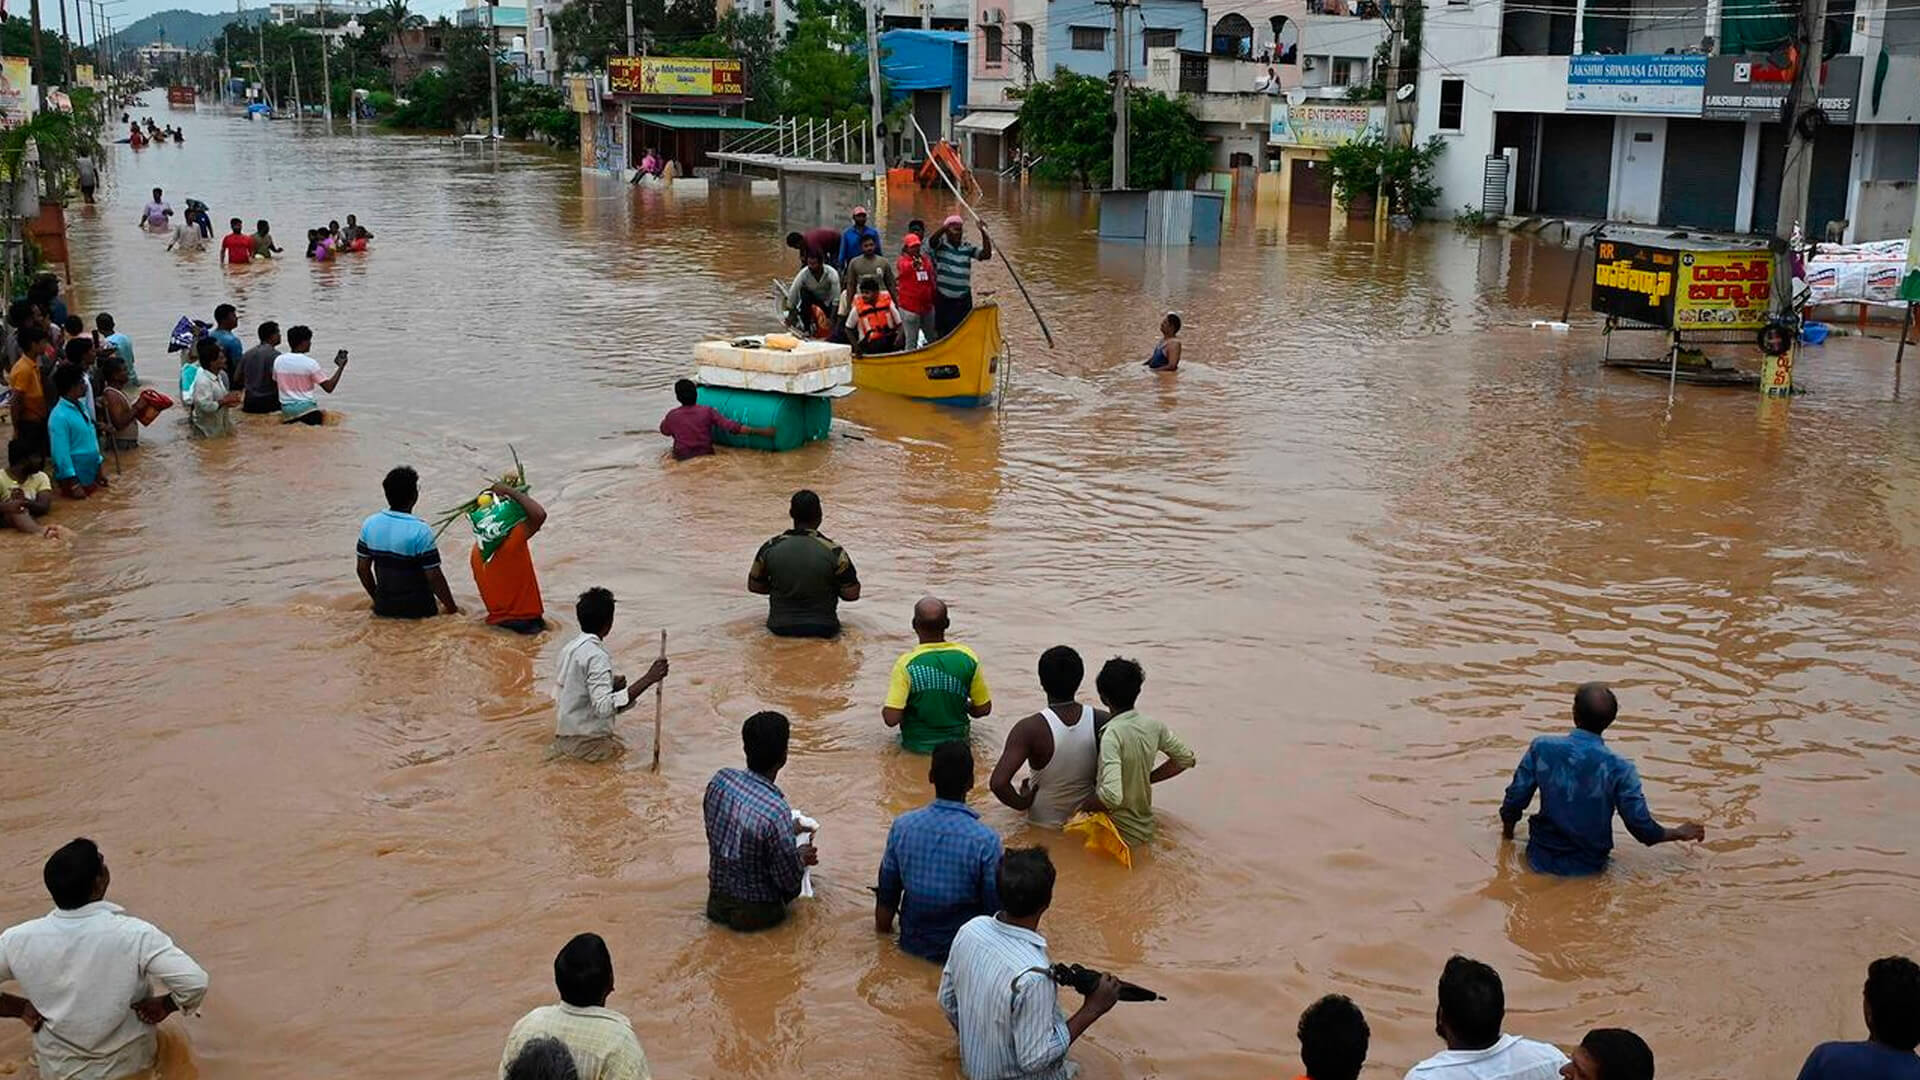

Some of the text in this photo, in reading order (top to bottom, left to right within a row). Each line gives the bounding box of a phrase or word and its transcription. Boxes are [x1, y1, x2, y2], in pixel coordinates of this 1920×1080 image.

[1569, 63, 1706, 78] LAKSHMI SRINIVASA ENTERPRISES
[1307, 107, 1368, 122] ENTERPRISES
[1600, 243, 1615, 259] RR
